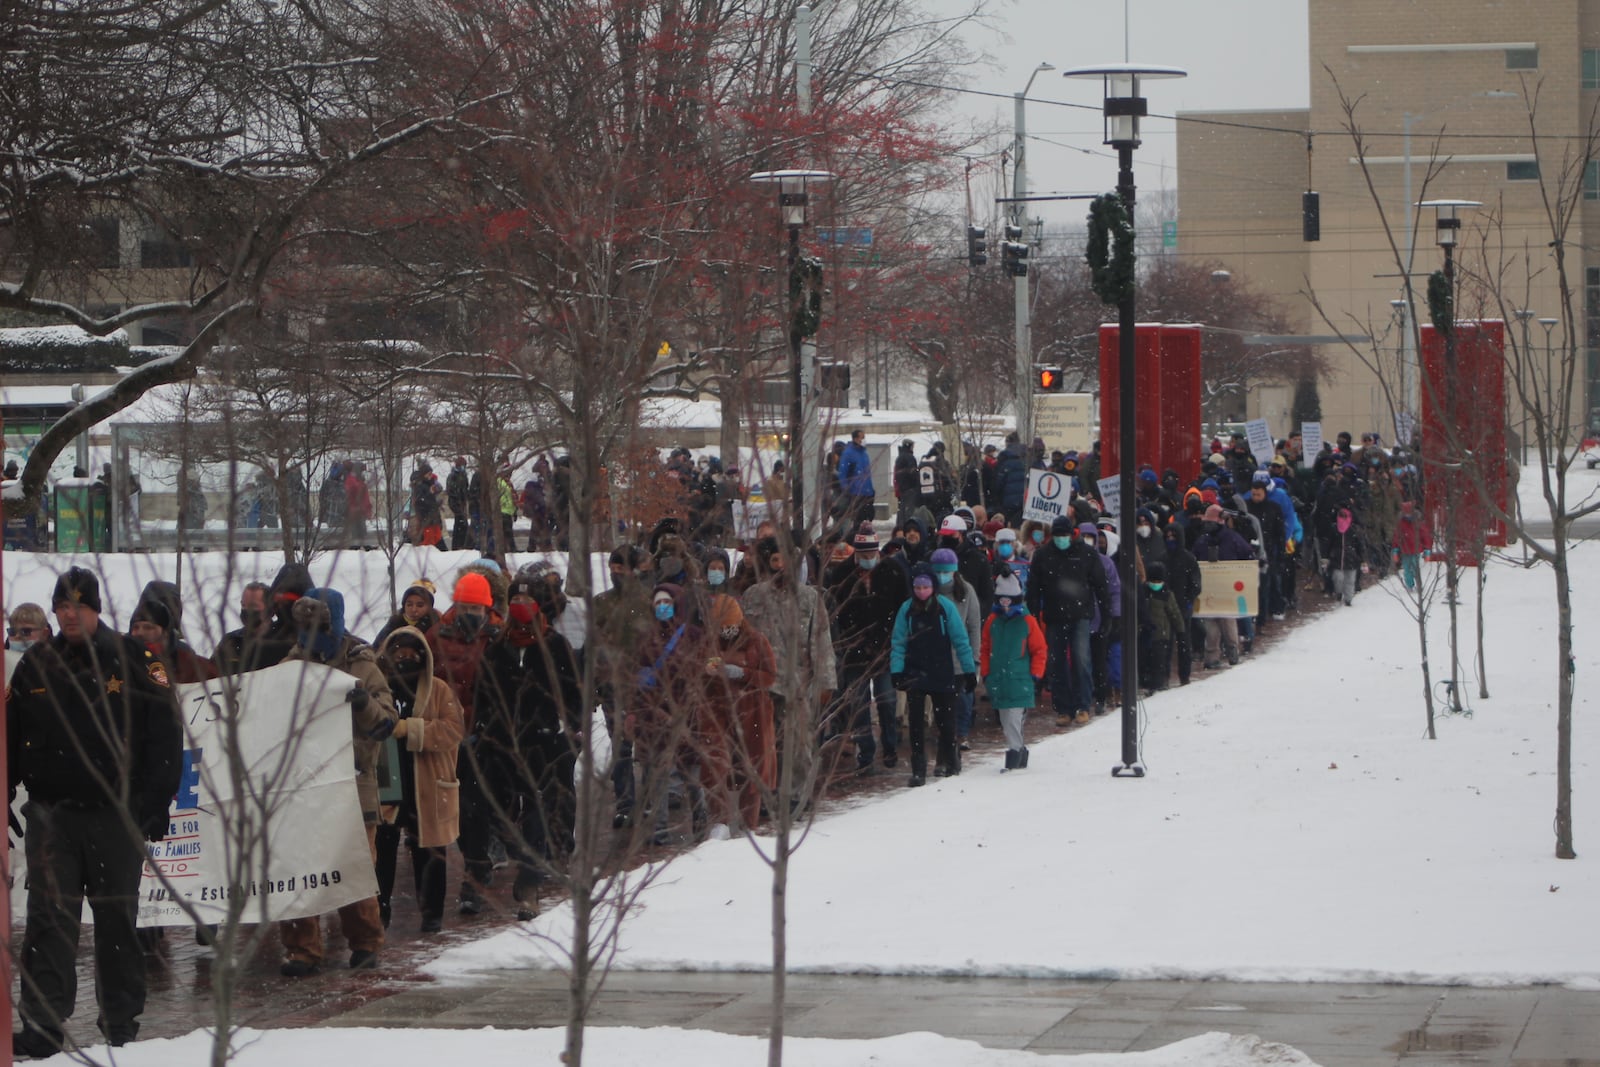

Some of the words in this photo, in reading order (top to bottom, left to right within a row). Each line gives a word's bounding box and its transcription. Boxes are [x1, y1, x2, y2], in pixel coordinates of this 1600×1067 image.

[1031, 496, 1062, 516] Liberty
[182, 820, 200, 833] FOR
[201, 876, 295, 901] Estihed
[302, 870, 342, 890] 1949
